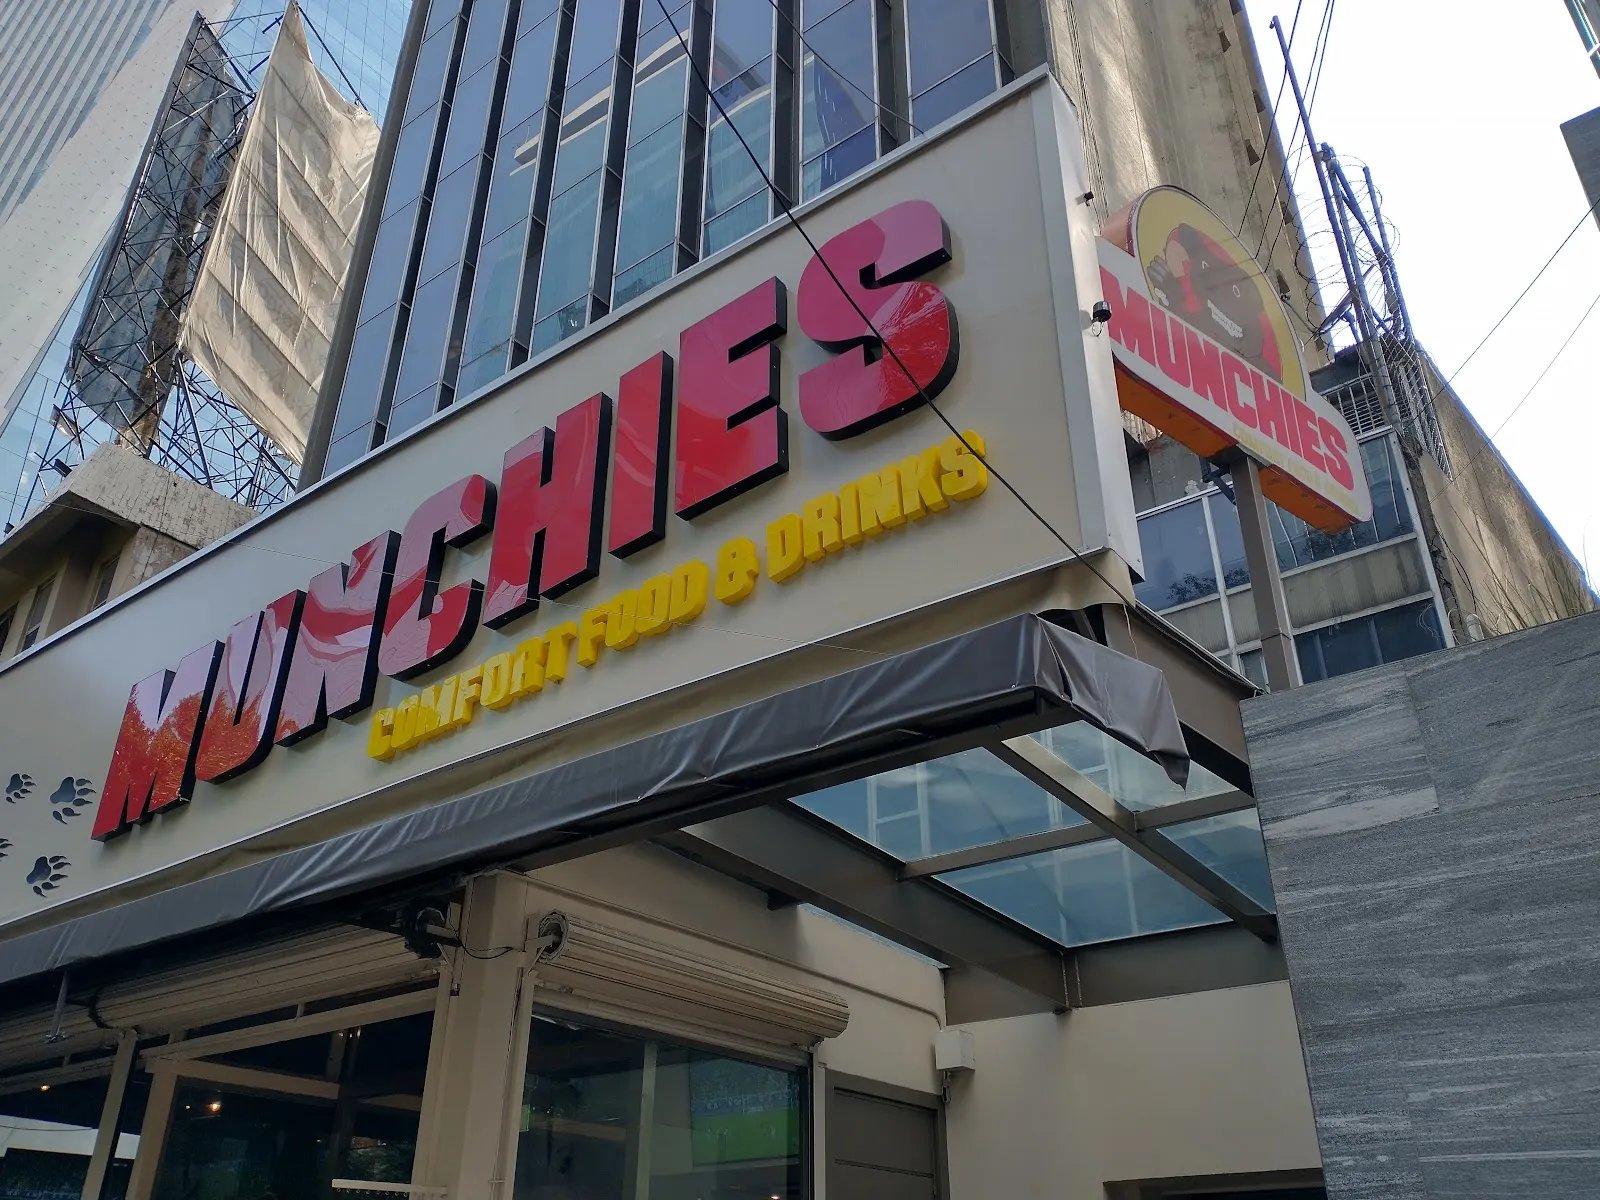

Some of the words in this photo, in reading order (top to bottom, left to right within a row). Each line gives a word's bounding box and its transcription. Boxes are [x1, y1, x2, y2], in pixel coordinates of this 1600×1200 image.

[92, 199, 959, 841] MUNCHIES
[1099, 264, 1354, 491] MUNCHIES
[367, 621, 577, 761] COMFORT
[576, 559, 709, 667] FOOD
[714, 536, 759, 604] &
[767, 429, 988, 583] DRINKS
